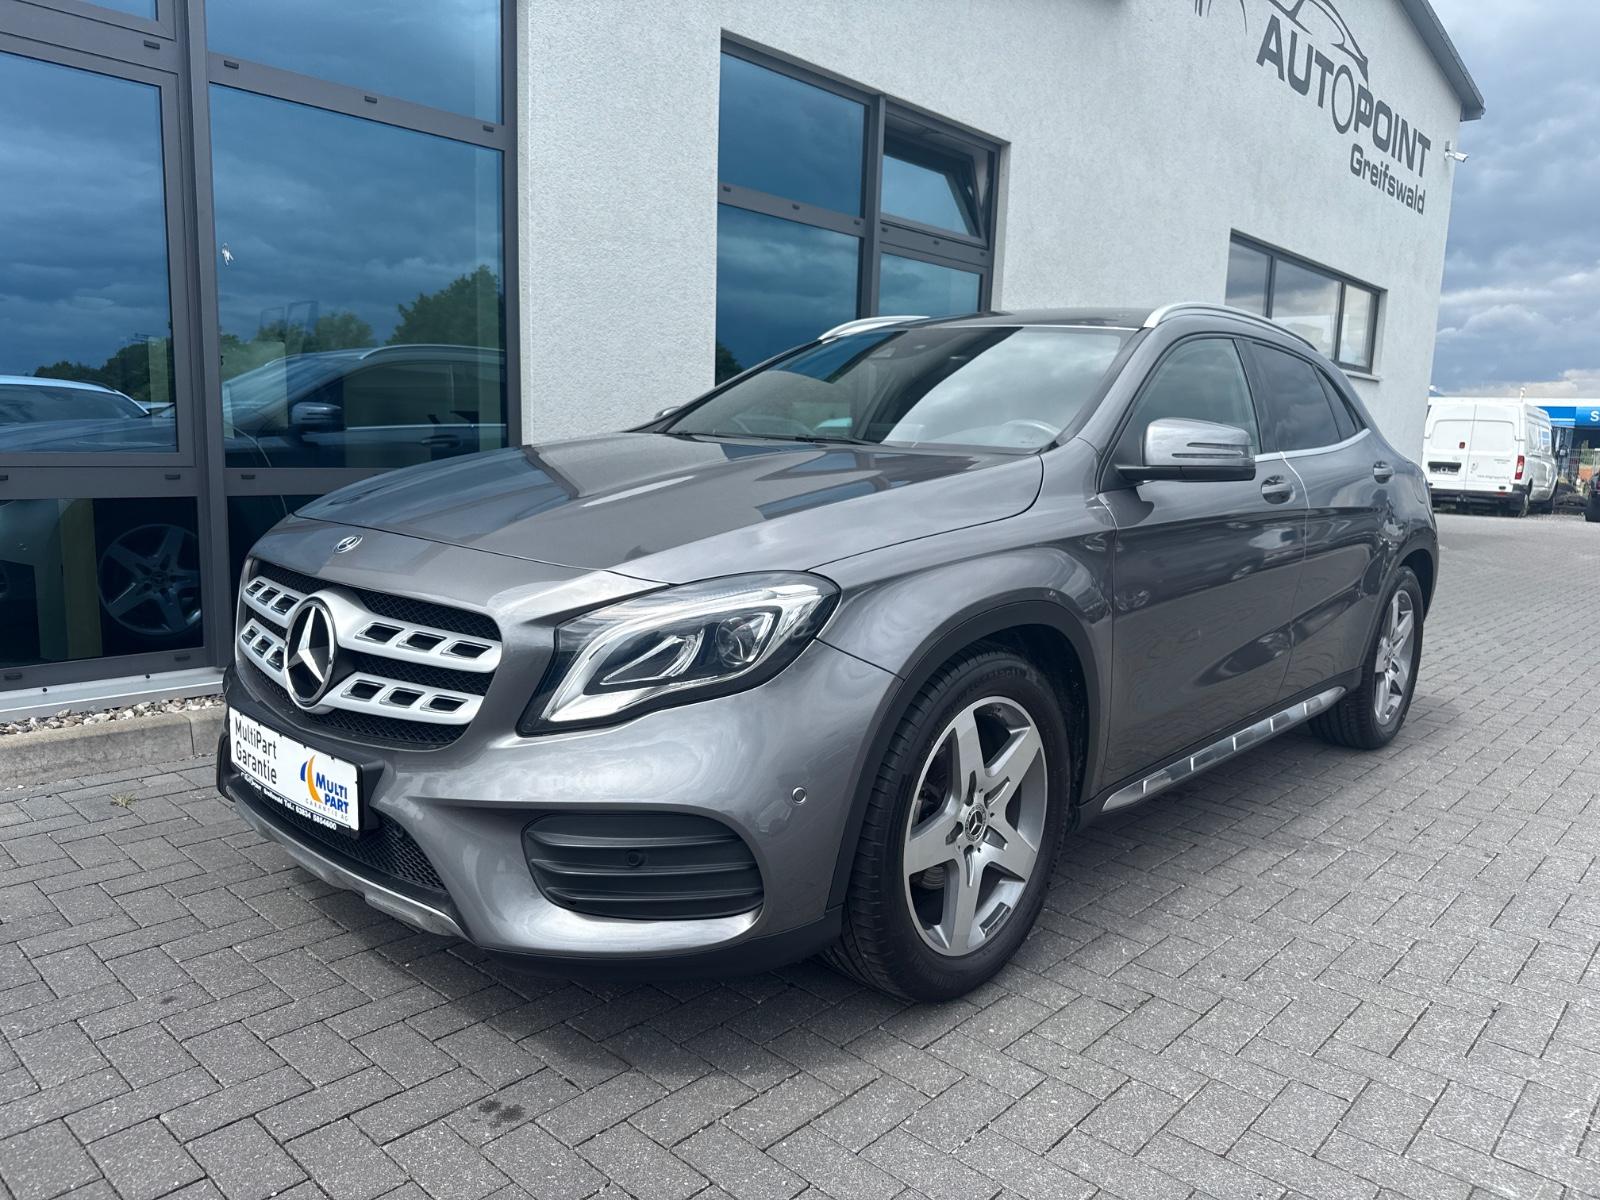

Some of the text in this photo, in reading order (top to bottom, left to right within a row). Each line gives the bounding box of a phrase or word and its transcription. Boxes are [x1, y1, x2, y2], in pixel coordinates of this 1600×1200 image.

[1256, 14, 1431, 177] AUTOPOINT
[1350, 143, 1426, 215] Greifswald
[235, 717, 277, 760] MultiPart
[235, 741, 277, 785] Garantie
[315, 772, 348, 800] MULTI
[324, 793, 349, 814] PART
